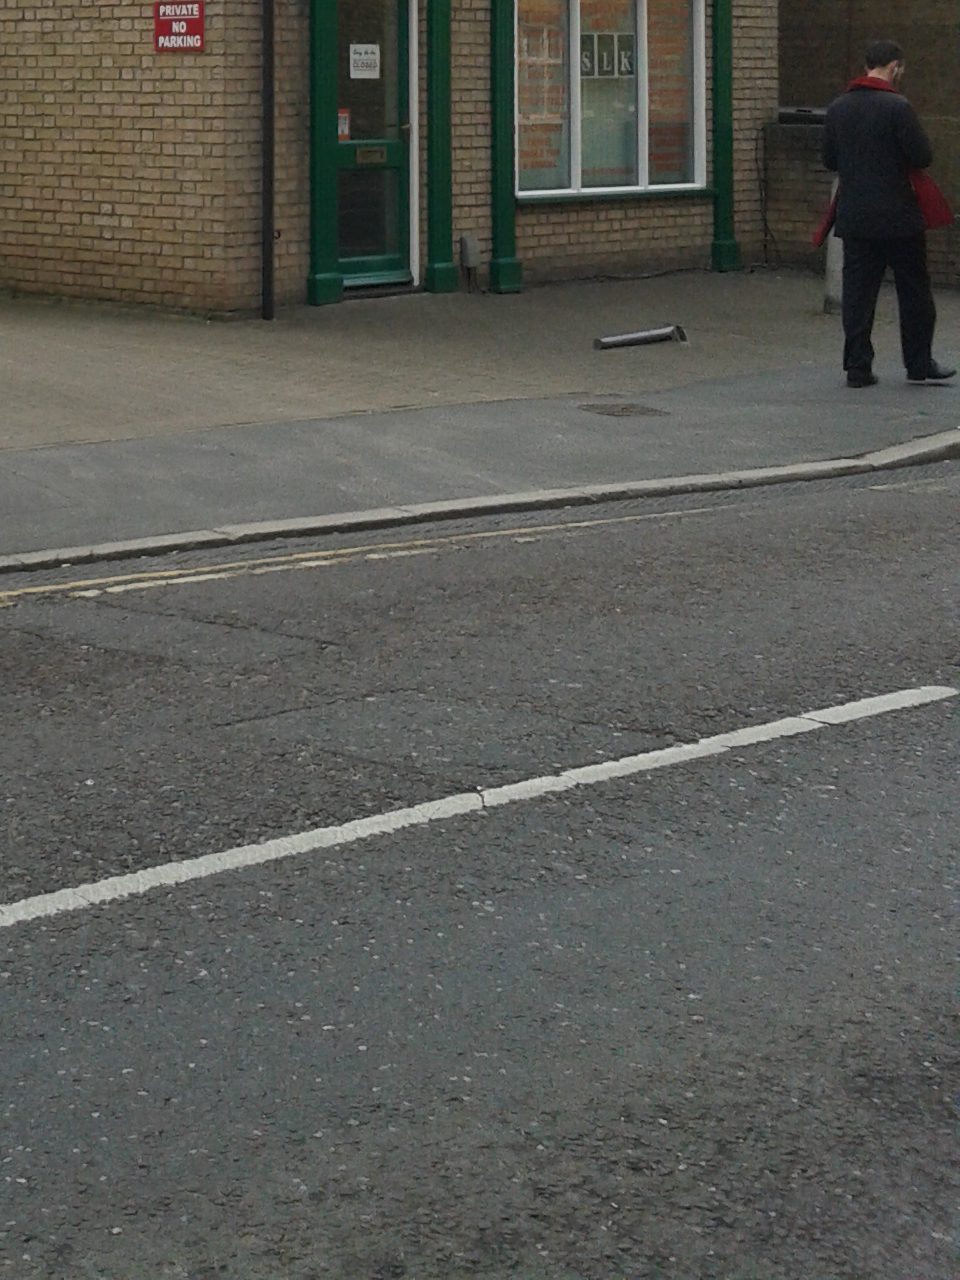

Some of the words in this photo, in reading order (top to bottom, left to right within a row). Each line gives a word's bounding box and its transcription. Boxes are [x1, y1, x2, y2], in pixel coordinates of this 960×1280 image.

[159, 4, 199, 16] PRIVATE
[172, 21, 187, 33] NO
[158, 35, 201, 48] PARKING
[581, 51, 632, 72] SLK
